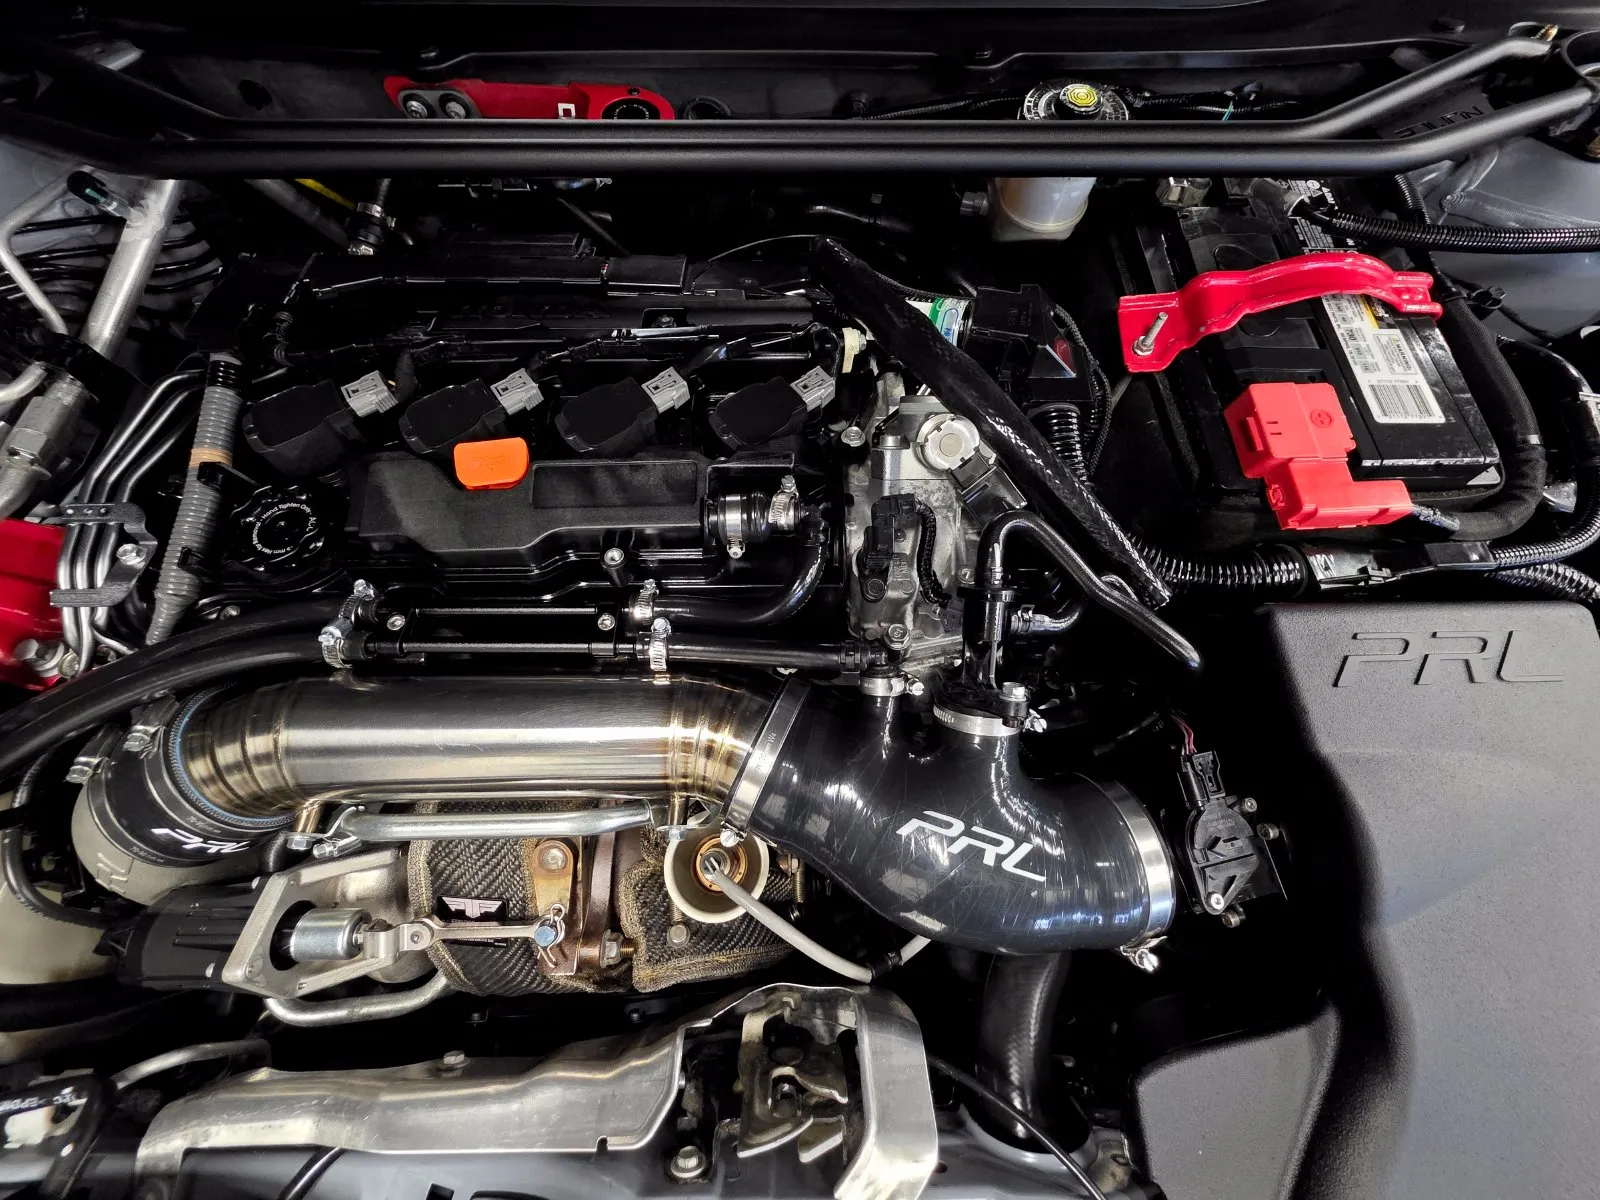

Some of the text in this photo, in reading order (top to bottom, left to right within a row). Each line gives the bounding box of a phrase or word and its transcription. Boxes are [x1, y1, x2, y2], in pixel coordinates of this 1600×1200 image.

[1344, 328, 1357, 340] 730
[261, 506, 279, 520] Hand
[277, 502, 301, 510] Tighten
[1332, 630, 1565, 688] PRL
[151, 828, 250, 853] PRL
[896, 809, 1048, 882] PRL
